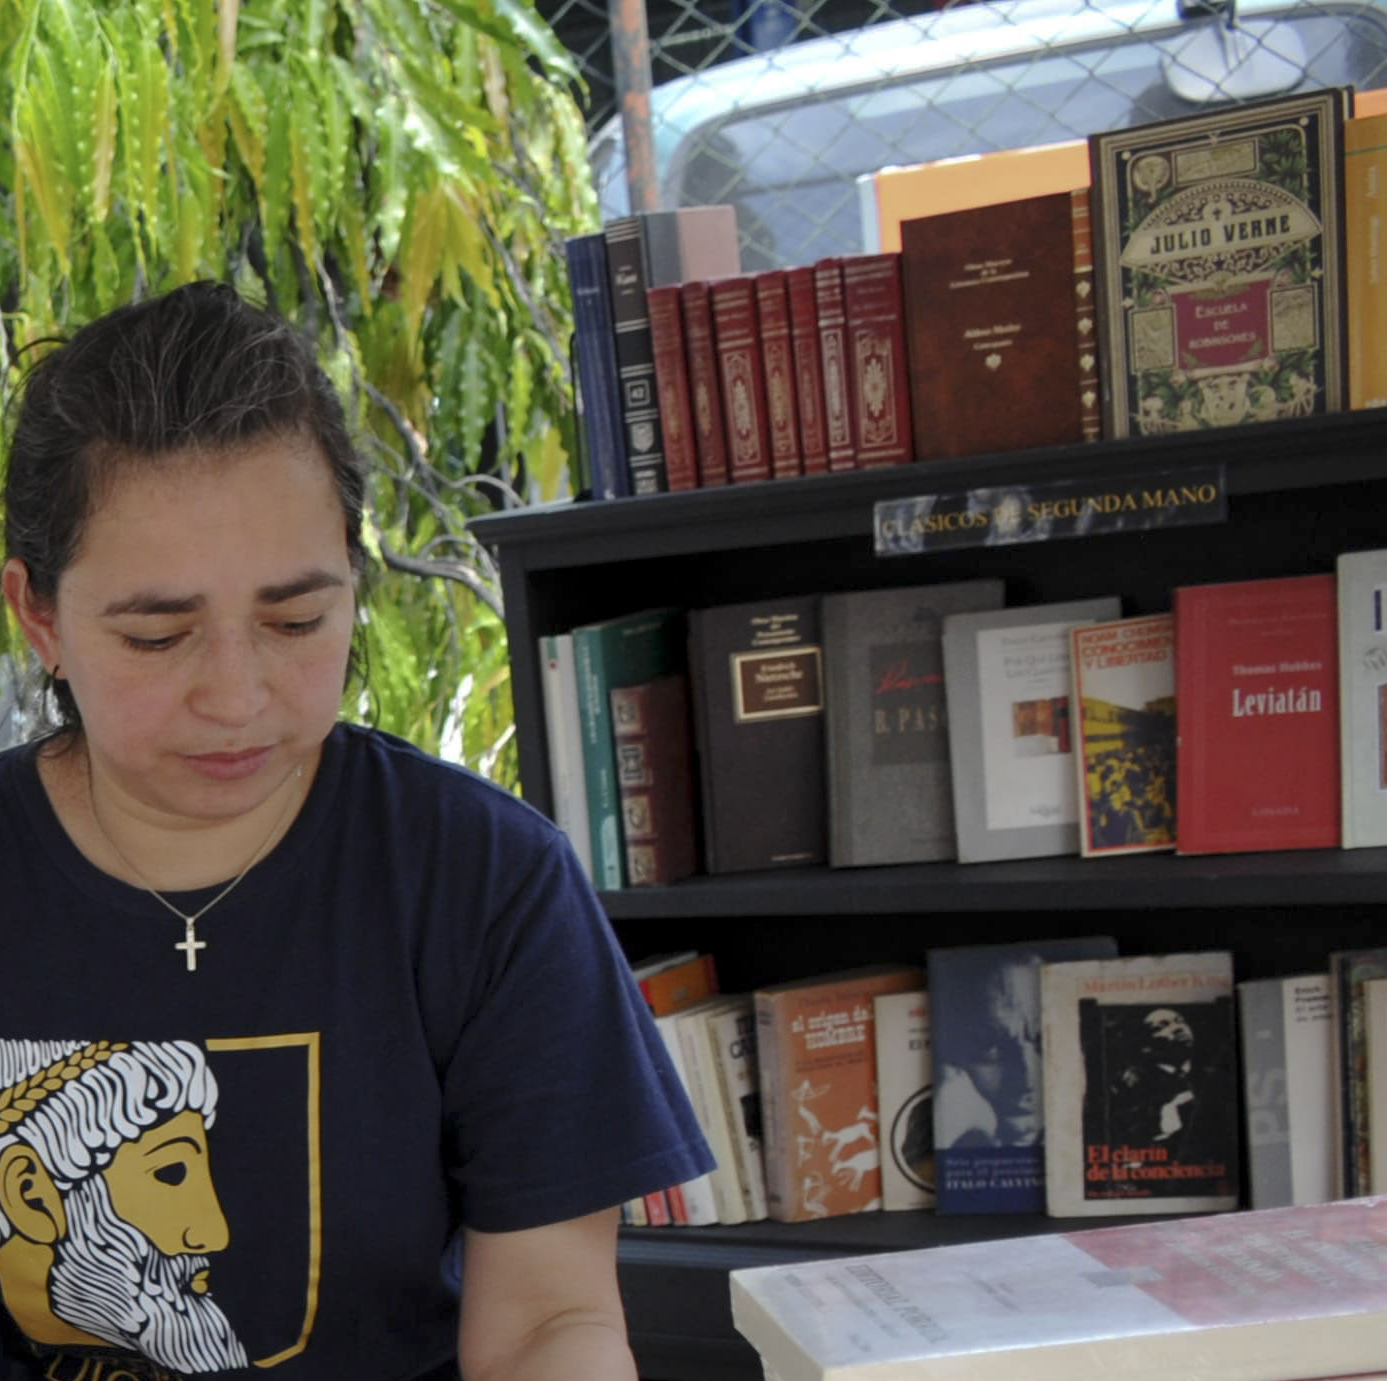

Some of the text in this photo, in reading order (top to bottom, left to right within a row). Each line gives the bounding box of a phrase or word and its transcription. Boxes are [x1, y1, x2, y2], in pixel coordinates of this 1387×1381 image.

[1151, 215, 1290, 255] JULIO VERNE
[1027, 493, 1138, 520] SEGUNDA
[1143, 484, 1216, 509] MANO
[1232, 664, 1277, 676] Thomas
[1232, 686, 1322, 718] Leviatán
[1087, 1146, 1109, 1163] El
